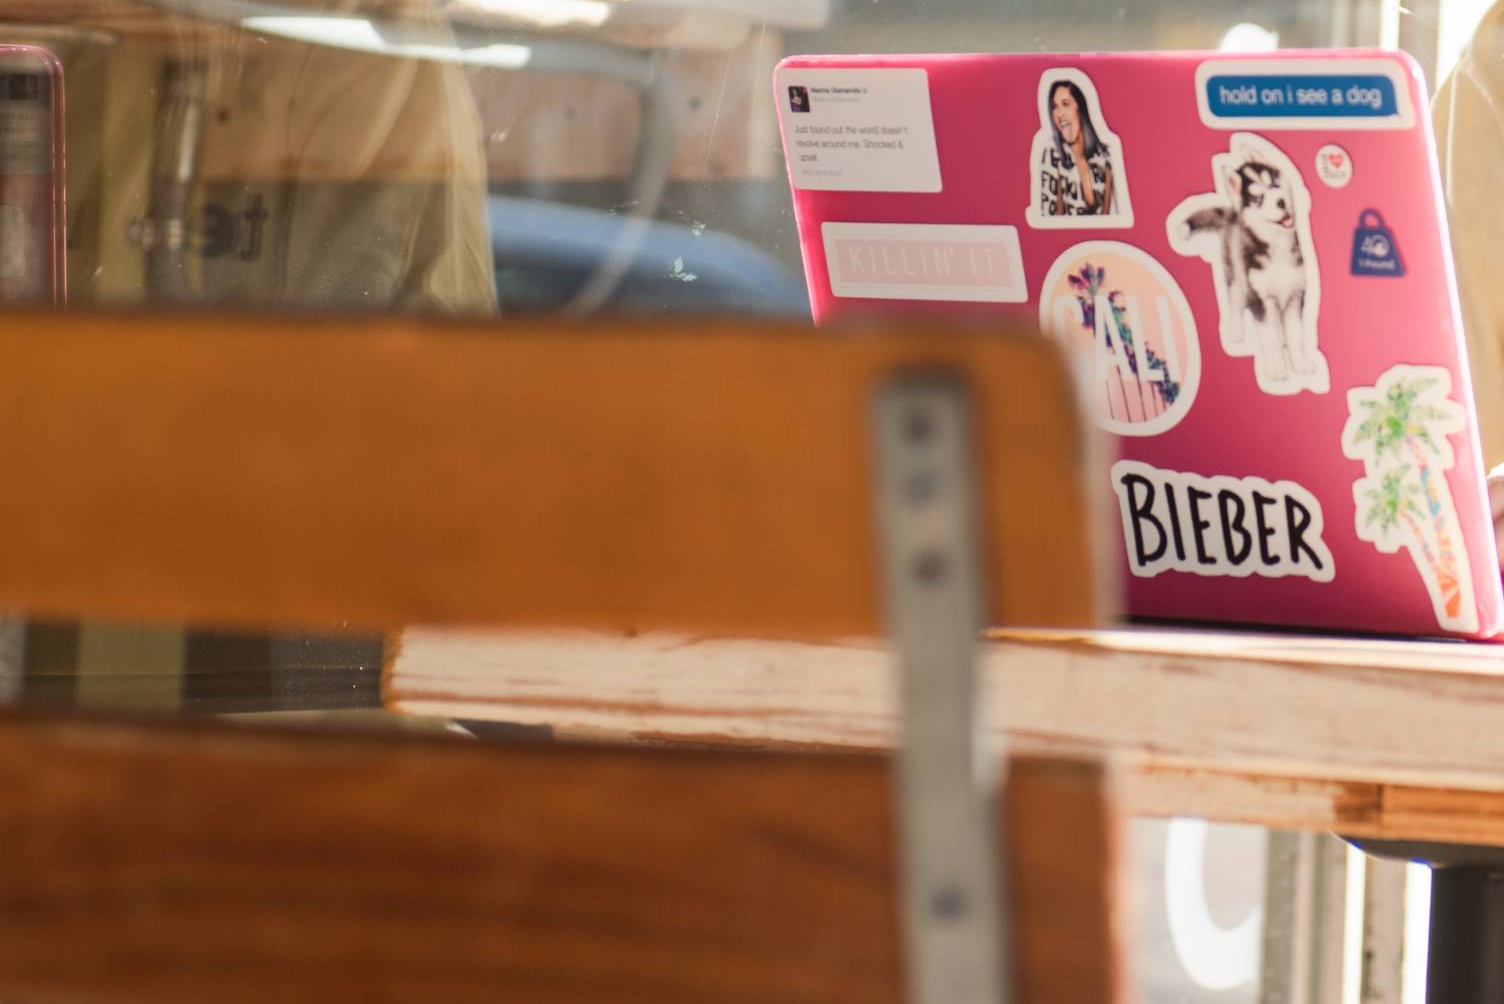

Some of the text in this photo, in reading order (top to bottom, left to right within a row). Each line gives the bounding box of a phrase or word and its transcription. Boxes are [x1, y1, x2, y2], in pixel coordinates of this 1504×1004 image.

[1219, 84, 1383, 109] hold on i see a dog
[969, 248, 996, 277] IT
[1122, 473, 1324, 570] BIEBER
